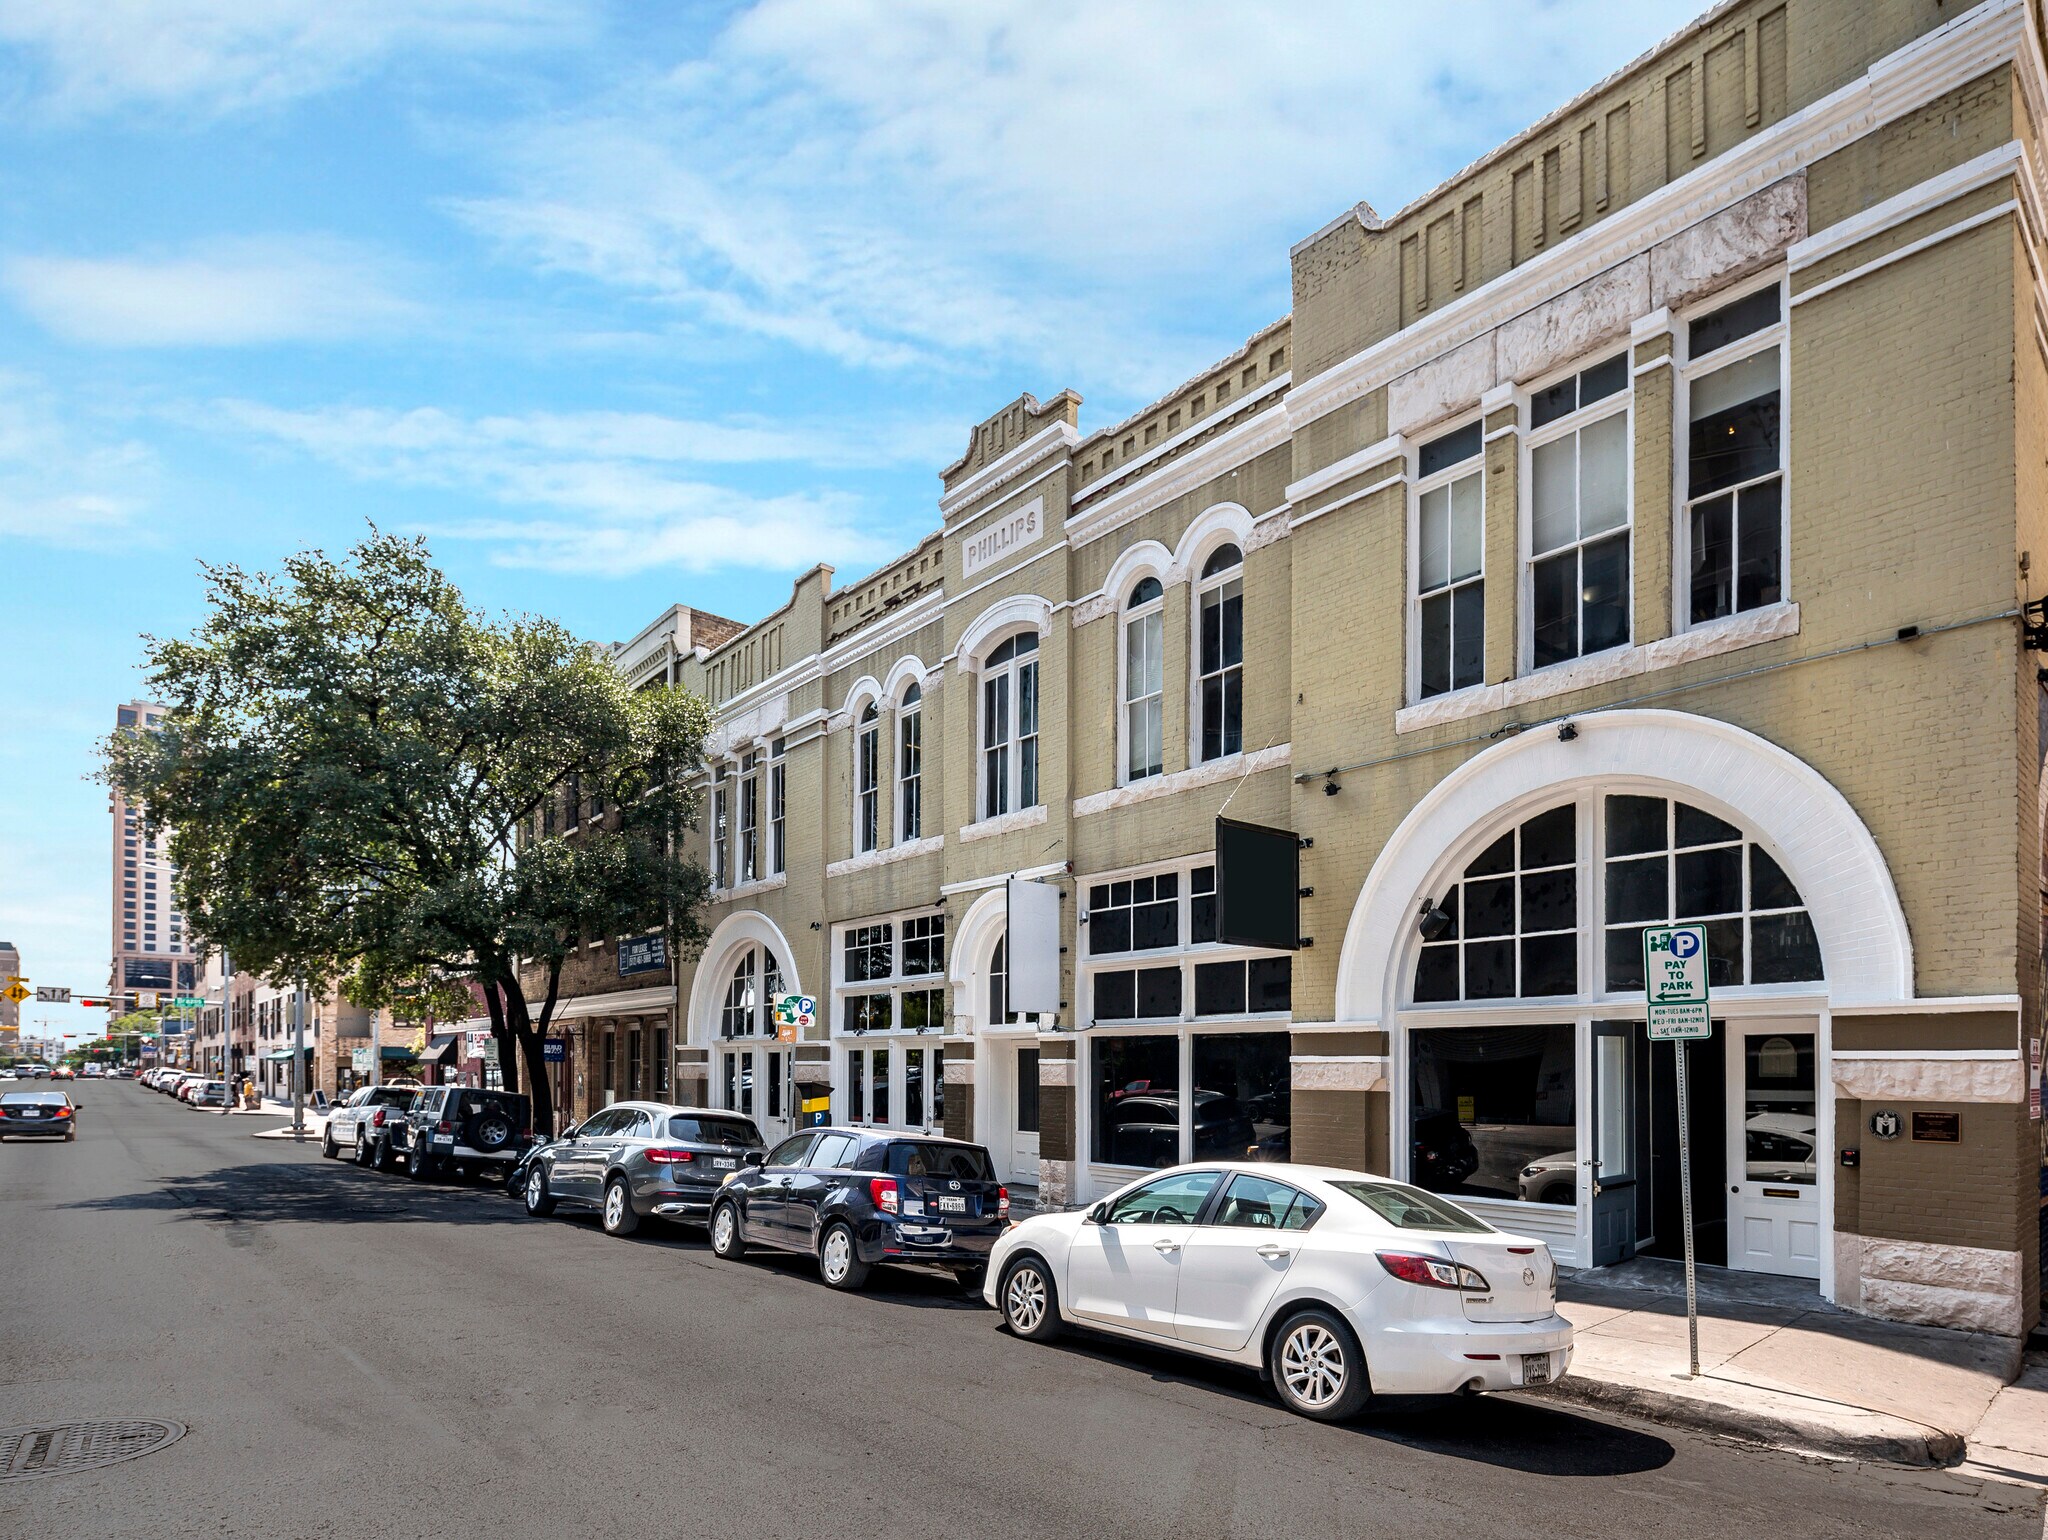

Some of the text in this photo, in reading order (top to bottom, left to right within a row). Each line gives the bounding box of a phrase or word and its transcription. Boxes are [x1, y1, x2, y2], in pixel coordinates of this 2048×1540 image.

[968, 511, 1036, 568] PHILLIPS
[1676, 935, 1695, 957] P
[1664, 960, 1687, 970] PAY
[1668, 971, 1684, 980] TO
[1660, 981, 1694, 991] PARK
[801, 1000, 812, 1013] P
